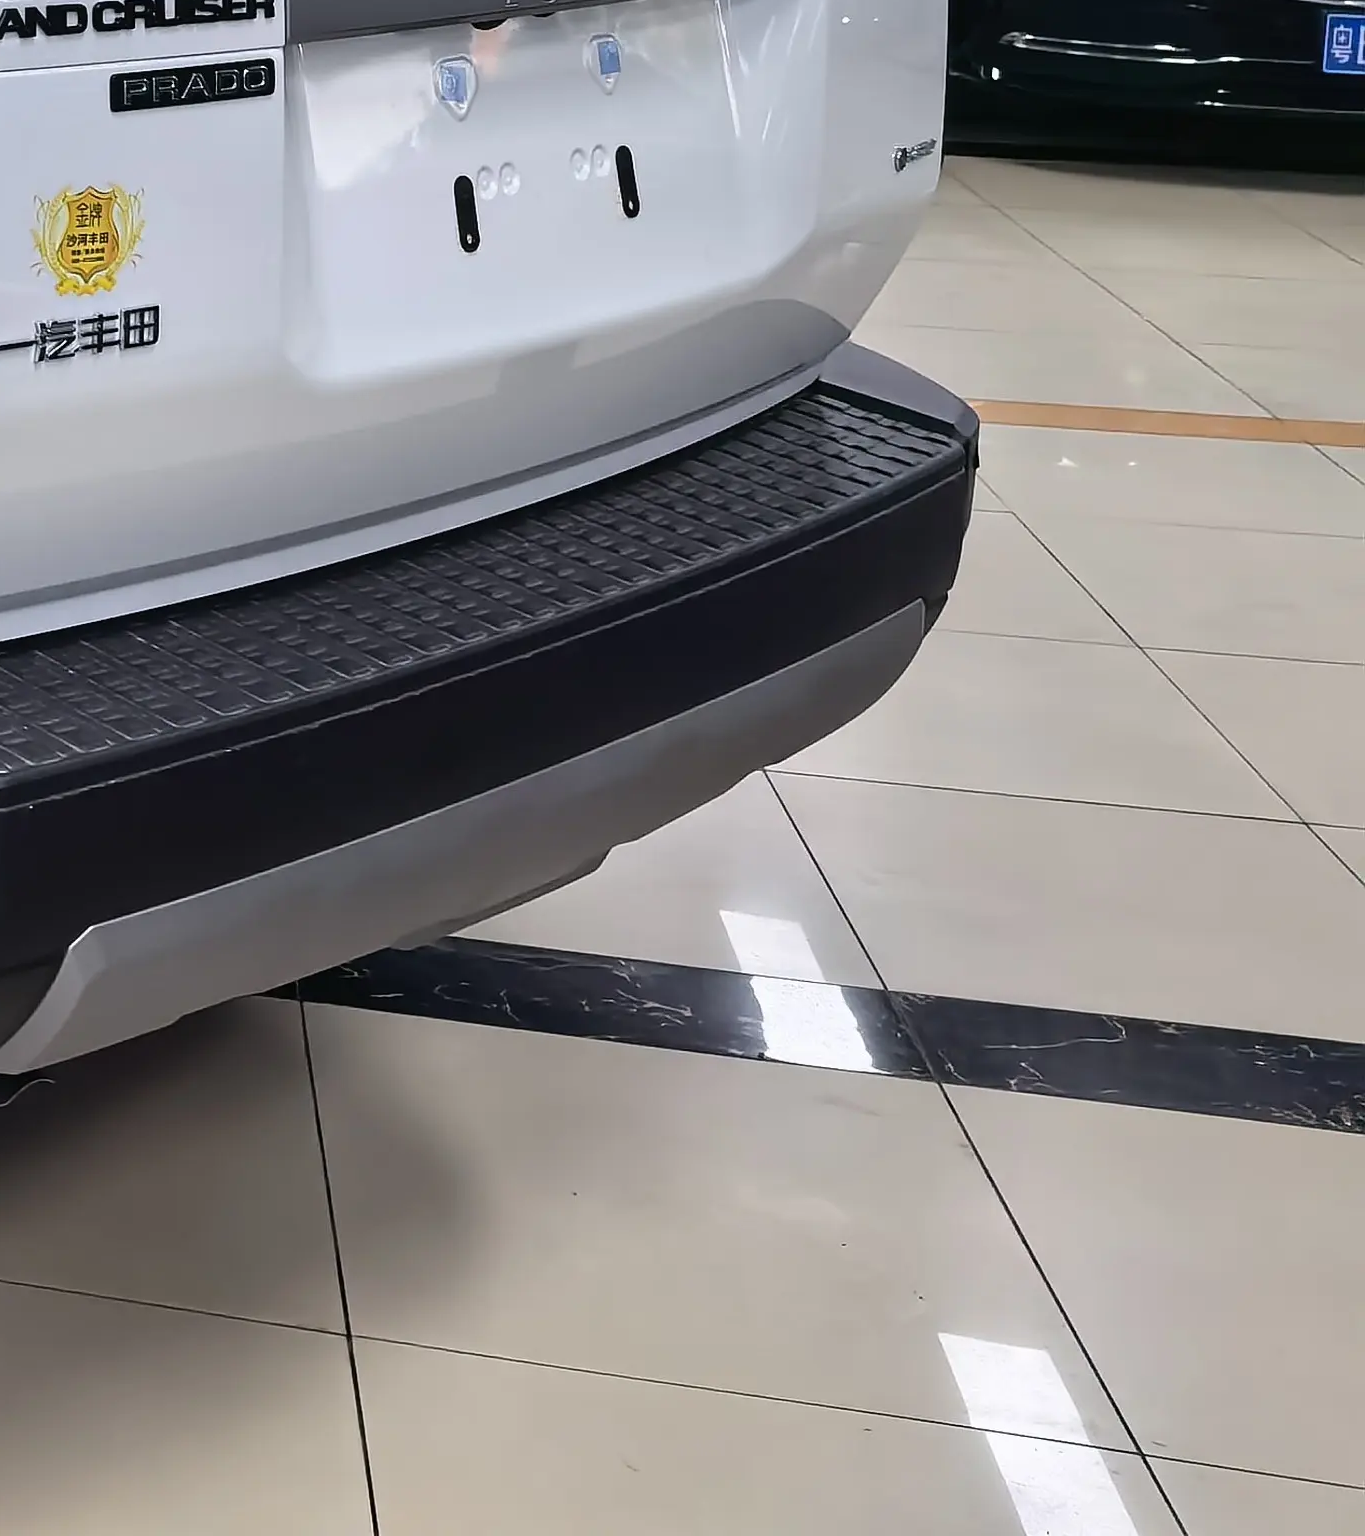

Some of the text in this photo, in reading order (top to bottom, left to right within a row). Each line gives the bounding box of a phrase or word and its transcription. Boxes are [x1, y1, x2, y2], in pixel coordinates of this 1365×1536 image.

[123, 65, 269, 106] PRADO
[66, 232, 109, 247] 沙河丰田
